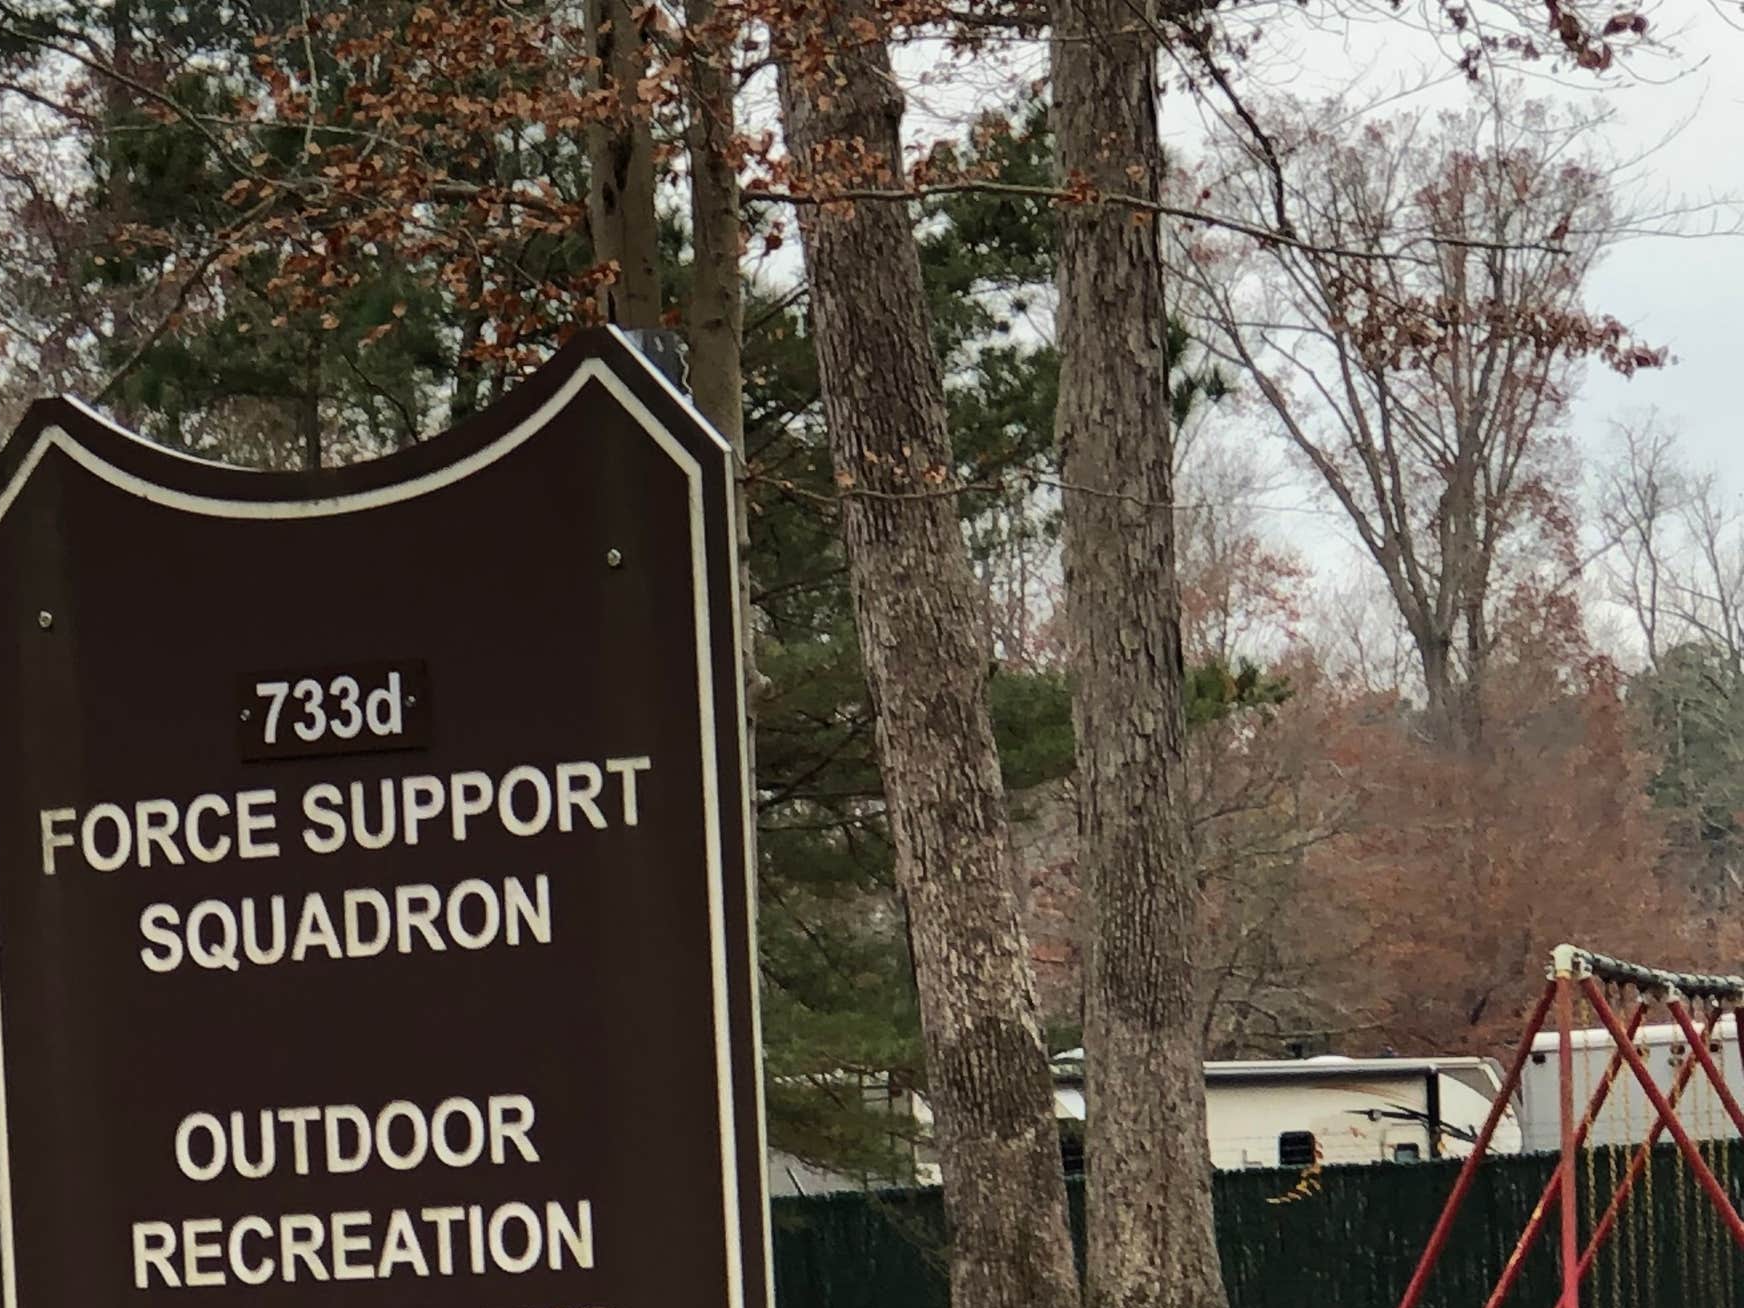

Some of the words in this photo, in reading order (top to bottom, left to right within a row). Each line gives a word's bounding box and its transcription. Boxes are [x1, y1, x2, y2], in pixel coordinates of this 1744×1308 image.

[256, 671, 403, 745] 733d
[40, 789, 281, 875] FORCE
[302, 756, 652, 855] SUPPORT
[140, 874, 552, 974] SQUADRON
[175, 1094, 541, 1182] OUTDOOR
[132, 1199, 595, 1290] RECREATION
